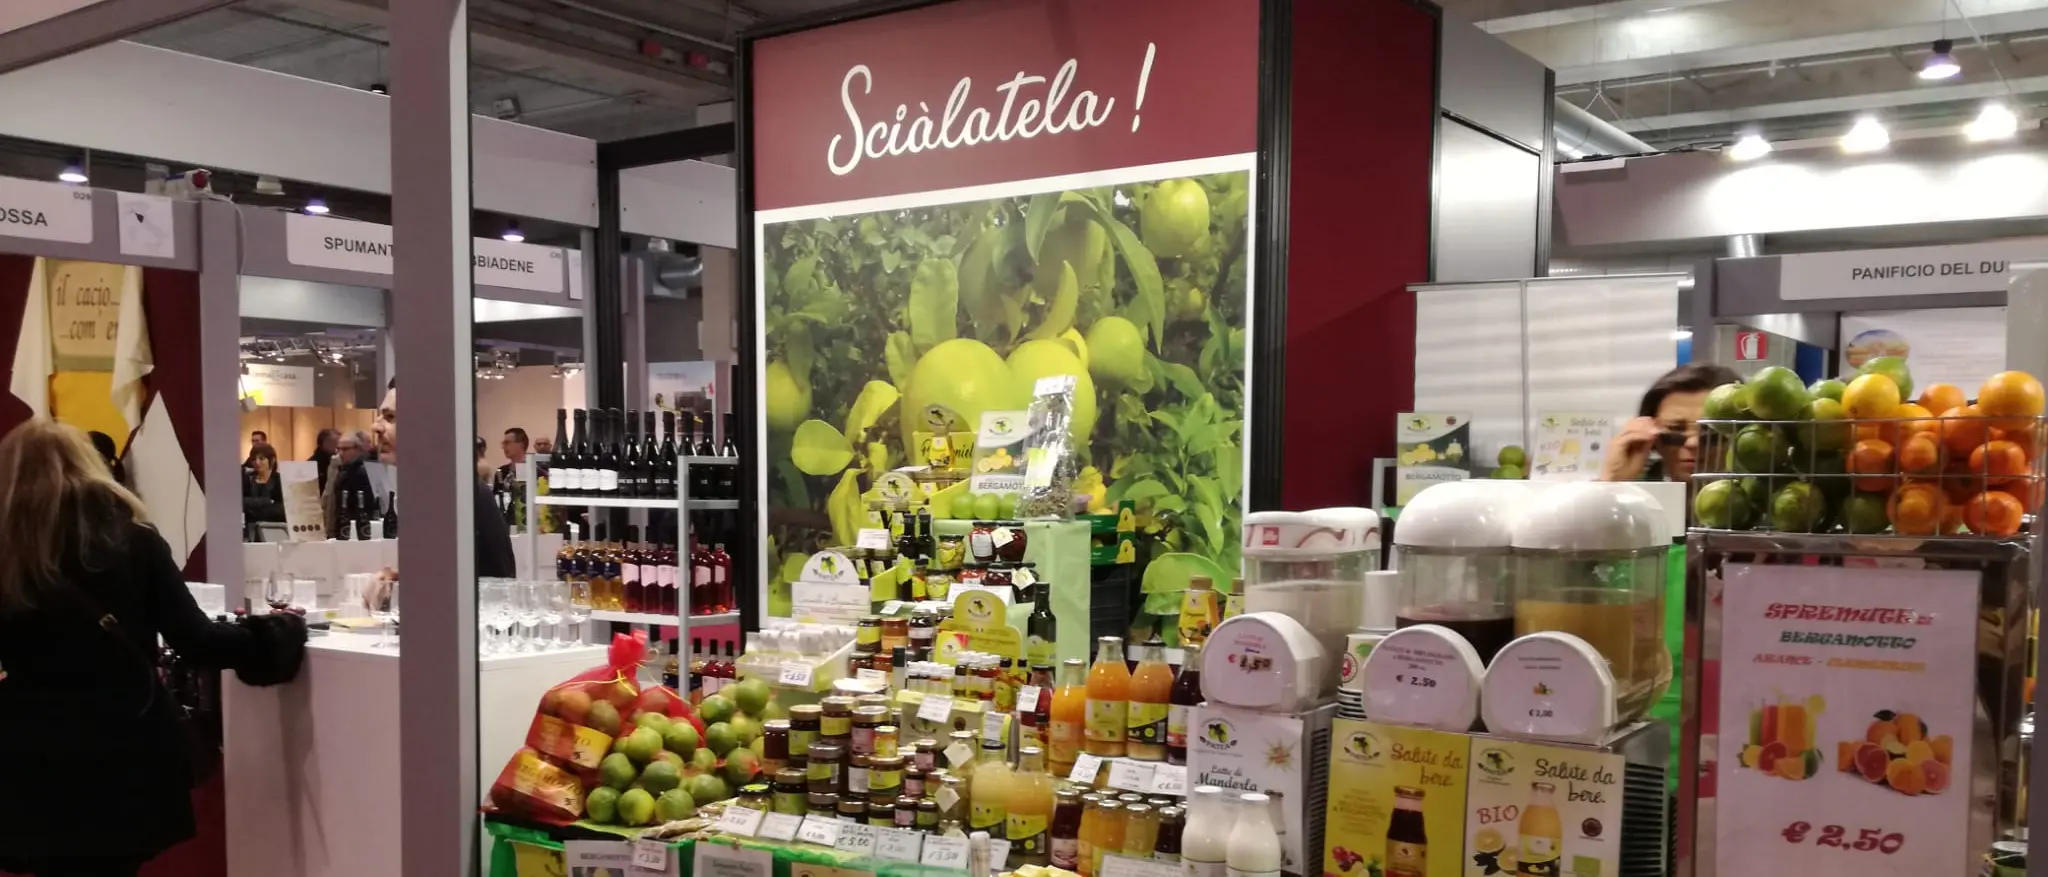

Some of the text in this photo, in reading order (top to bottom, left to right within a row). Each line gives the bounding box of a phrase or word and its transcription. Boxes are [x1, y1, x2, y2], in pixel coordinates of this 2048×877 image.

[828, 42, 1156, 175] Sciàlatela !
[1852, 262, 1936, 280] PANIFICIO
[1940, 262, 1974, 276] DEL
[56, 274, 71, 306] il
[1764, 603, 1915, 625] SPREMUTE
[1779, 630, 1917, 649] BERGAMOTTO
[1396, 674, 1404, 682] €
[1391, 743, 1437, 766] Salute
[1442, 751, 1463, 769] da
[1194, 772, 1258, 792] Mandorla
[1419, 766, 1454, 787] bere
[1534, 757, 1589, 782] Salute
[1592, 765, 1616, 785] da
[1567, 781, 1606, 804] bere
[1477, 804, 1519, 824] BIO
[1782, 821, 1904, 854] € 2.50
